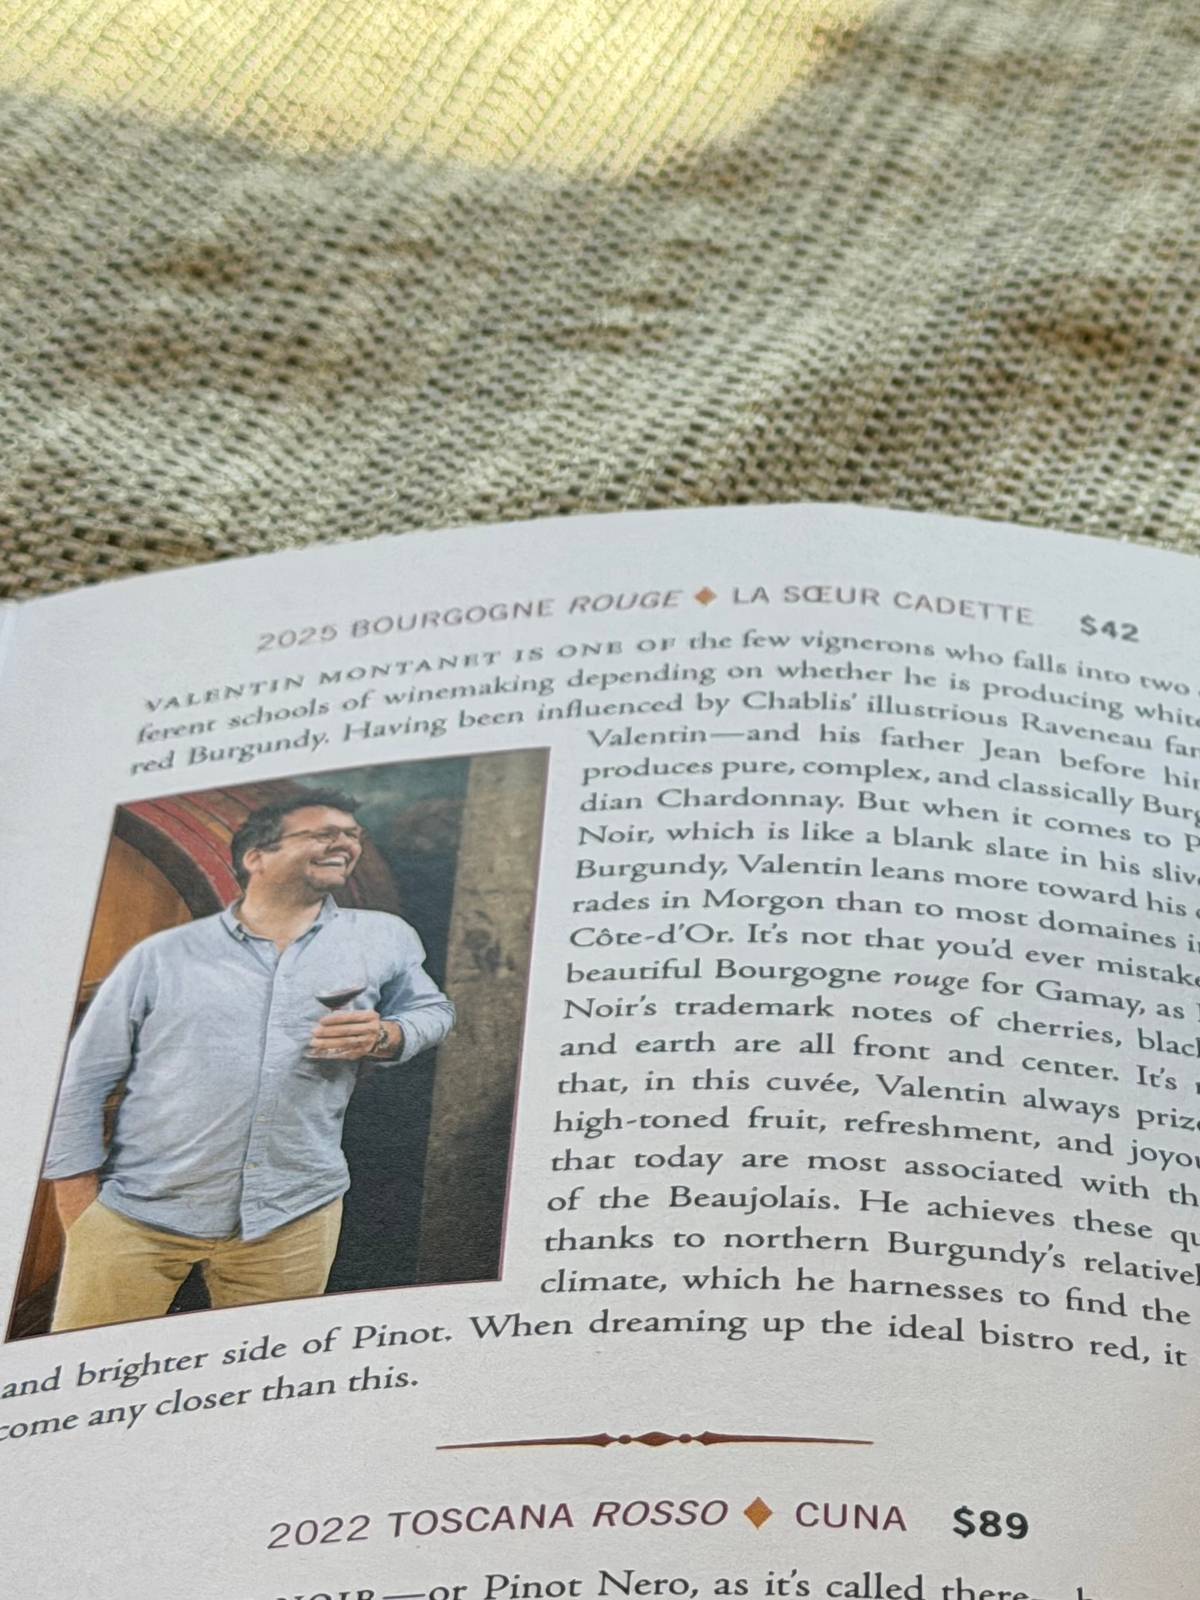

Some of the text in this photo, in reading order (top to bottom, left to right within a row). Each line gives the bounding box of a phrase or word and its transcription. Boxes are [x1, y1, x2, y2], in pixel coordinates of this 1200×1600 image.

[257, 625, 337, 653] 2025
[351, 599, 553, 638] BOURGOGNE
[568, 590, 682, 614] ROUGE
[733, 586, 770, 604] LA
[893, 592, 1032, 626] CADETTE
[1080, 614, 1139, 643] $42
[145, 675, 304, 712] VALENTIN
[319, 651, 501, 685] MONTANET
[515, 647, 543, 663] IS
[556, 642, 622, 658] ONE
[636, 638, 675, 652] OF
[689, 631, 732, 650] the
[742, 629, 790, 648] few
[801, 630, 935, 657] vignerons
[945, 644, 1003, 666] who
[1014, 650, 1067, 675] falls
[1077, 661, 1130, 684] into
[1140, 676, 1190, 696] two
[580, 792, 642, 812] dian
[657, 786, 844, 814] Chardonnay.
[858, 791, 909, 813] But
[922, 797, 999, 823] when
[1013, 807, 1032, 827] it
[1045, 817, 1131, 841] comes
[1144, 832, 1171, 848] to
[747, 923, 788, 944] It's
[802, 932, 852, 946] not
[865, 927, 924, 951] that
[937, 938, 1013, 960] you'd
[1025, 950, 1085, 968] ever
[560, 1032, 617, 1057] and
[635, 1031, 715, 1053] earth
[734, 1039, 781, 1053] are
[799, 1032, 834, 1054] all
[853, 1034, 930, 1060] front
[948, 1045, 1004, 1068] and
[1022, 1057, 1119, 1081] center.
[1136, 1065, 1177, 1090] It's
[558, 1072, 628, 1095] that,
[645, 1070, 675, 1091] in
[692, 1068, 750, 1090] this
[766, 1072, 859, 1096] cuvée,
[875, 1074, 1006, 1105] Valentin
[1023, 1087, 1120, 1124] always
[553, 1105, 729, 1139] high-toned
[748, 1105, 826, 1134] fruit,
[845, 1110, 1040, 1149] refreshment,
[1057, 1133, 1114, 1156] and
[552, 1148, 616, 1172] that
[634, 1144, 723, 1176] today
[742, 1153, 788, 1168] are
[808, 1155, 886, 1172] most
[905, 1160, 1063, 1188] associated
[1081, 1174, 1149, 1200] with
[547, 1186, 585, 1211] of
[599, 1186, 649, 1209] the
[669, 1185, 840, 1215] Beaujolais.
[860, 1189, 908, 1214] He
[927, 1195, 1055, 1227] achieves
[1073, 1208, 1152, 1239] these
[545, 1225, 654, 1252] thanks
[674, 1232, 705, 1248] to
[724, 1225, 869, 1252] northern
[888, 1231, 1065, 1274] Burgundy's
[540, 1268, 667, 1293] climate,
[682, 1265, 780, 1290] which
[796, 1267, 834, 1291] he
[849, 1269, 1003, 1303] harnesses
[1018, 1290, 1050, 1307] to
[1066, 1286, 1128, 1317] find
[1142, 1297, 1191, 1325] the
[0, 1365, 62, 1399] and
[76, 1352, 209, 1388] brighter
[222, 1335, 287, 1365] side
[302, 1326, 342, 1354] of
[352, 1325, 452, 1349] Pinot.
[469, 1313, 573, 1339] When
[589, 1308, 747, 1341] dreaming
[763, 1317, 805, 1341] up
[821, 1310, 872, 1335] the
[888, 1314, 964, 1342] ideal
[980, 1319, 1074, 1352] bistro
[1090, 1336, 1149, 1364] red,
[1164, 1343, 1187, 1367] it
[87, 1408, 143, 1430] any
[154, 1388, 252, 1416] closer
[263, 1375, 336, 1402] than
[349, 1366, 418, 1392] this.
[267, 1500, 1029, 1550] 2022 TOSCANA ROSSO CUNA $89
[483, 1574, 582, 1600] Pinot
[597, 1569, 699, 1599] Nero,
[713, 1578, 749, 1596] as
[765, 1568, 810, 1597] it's
[826, 1571, 924, 1600] called
